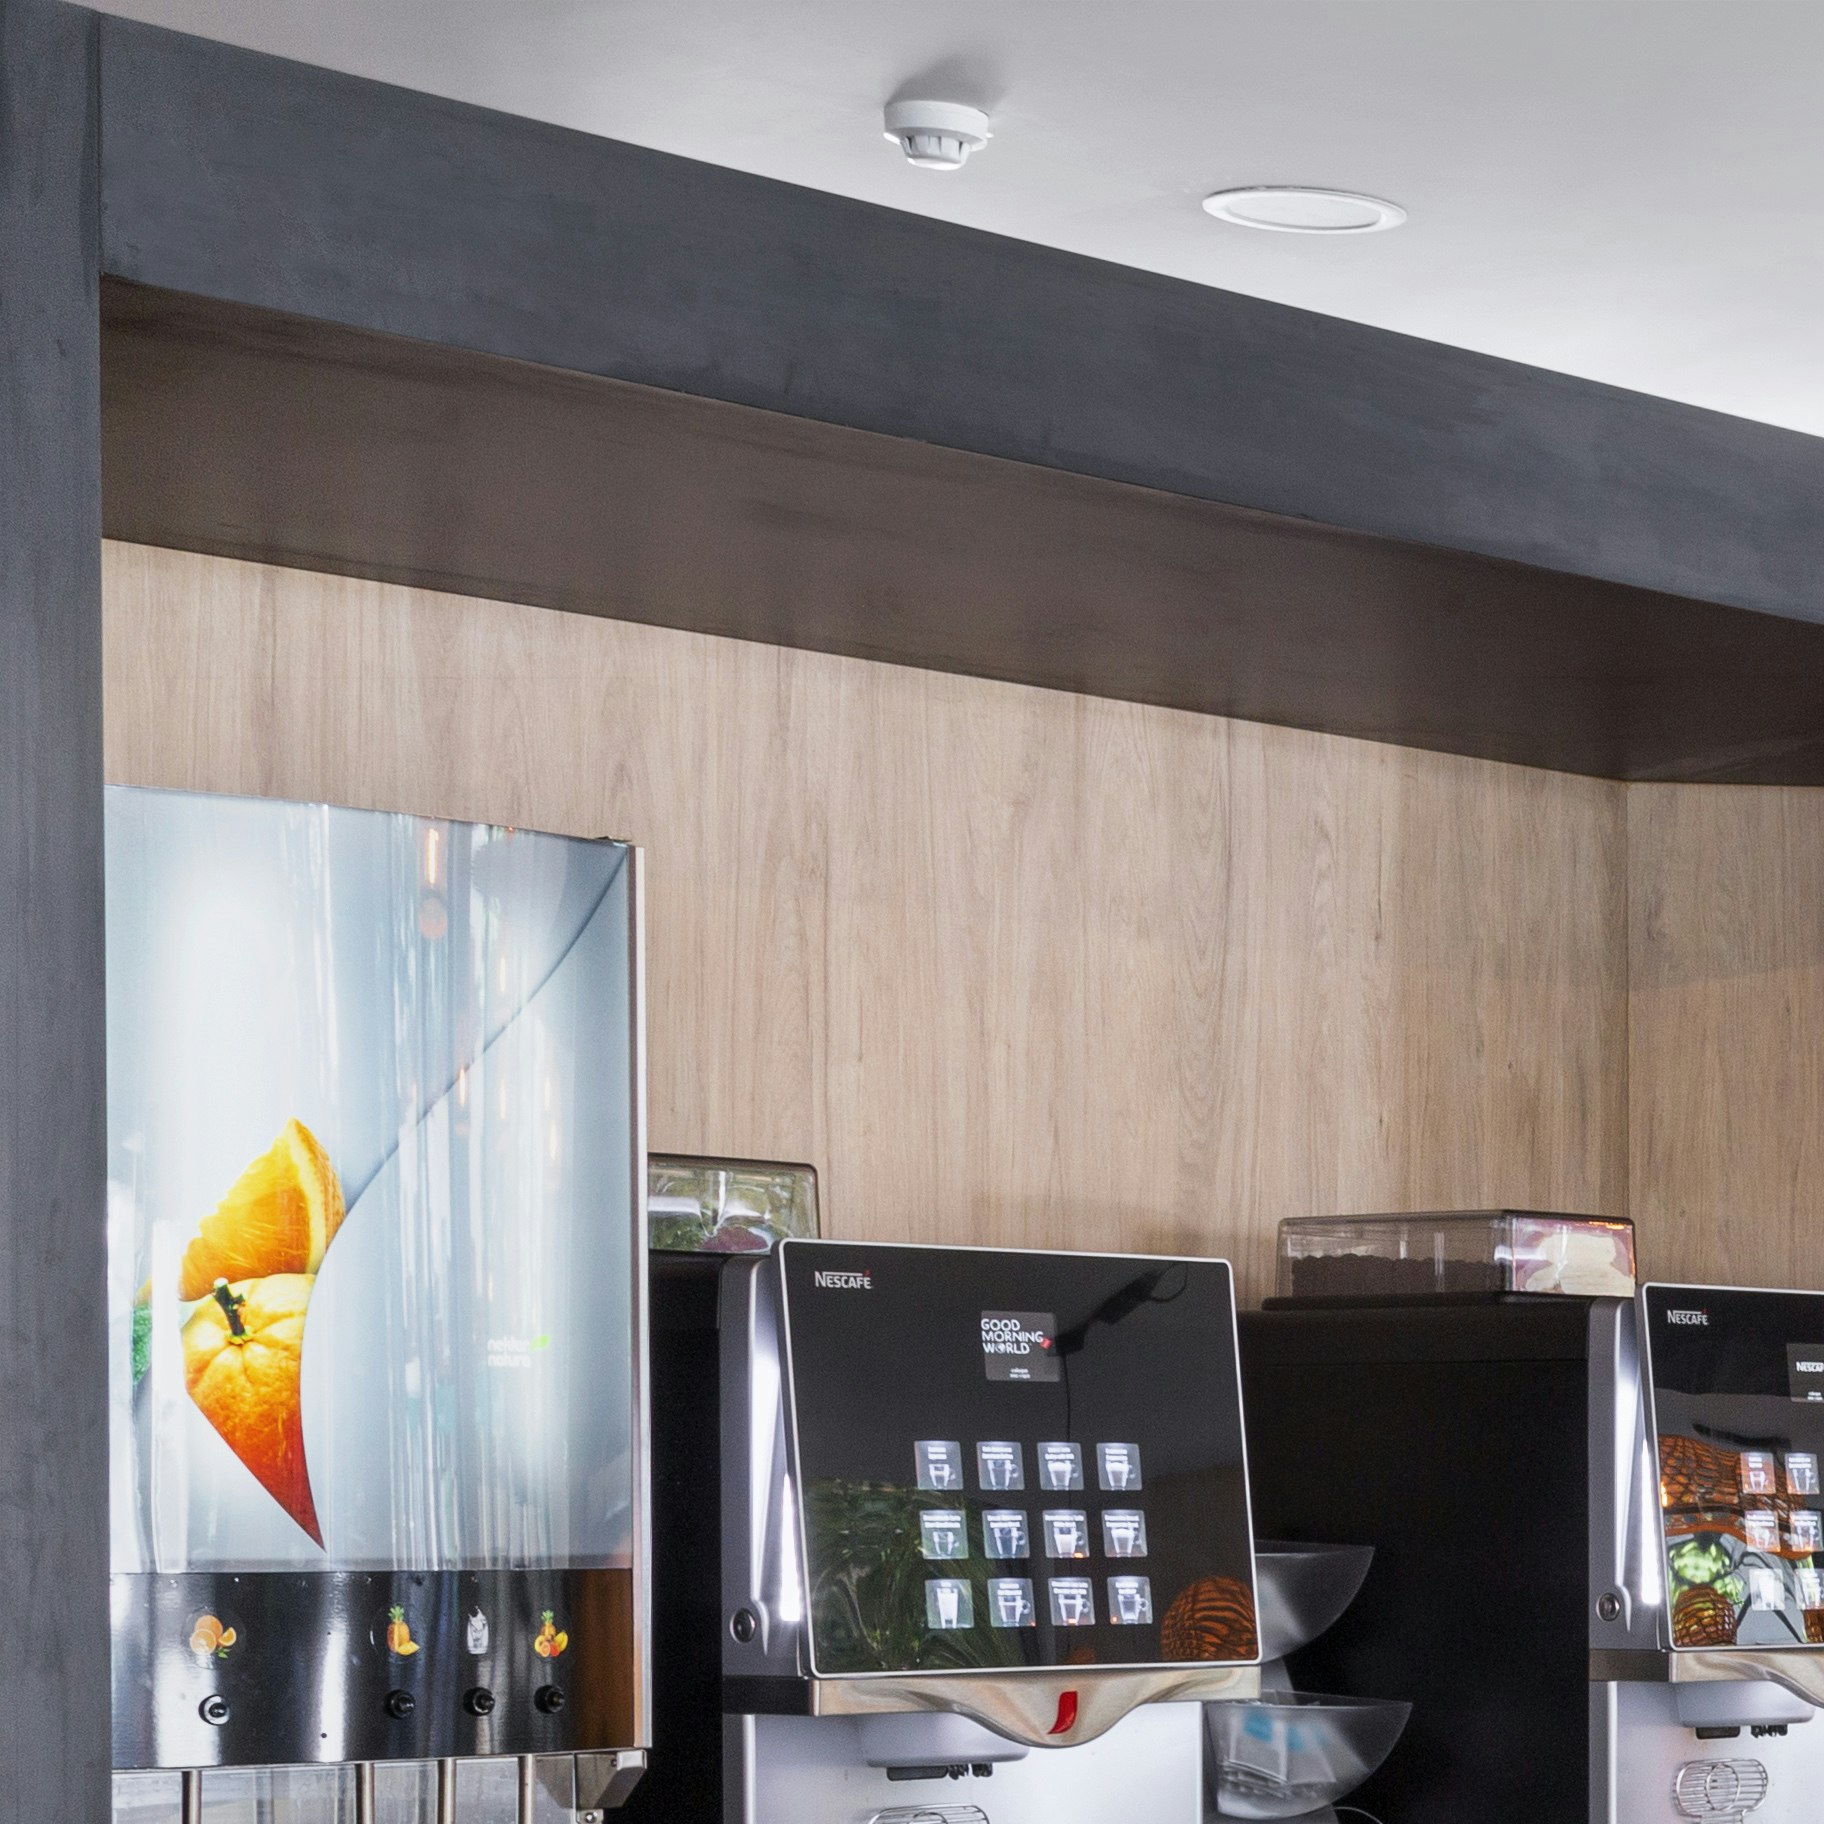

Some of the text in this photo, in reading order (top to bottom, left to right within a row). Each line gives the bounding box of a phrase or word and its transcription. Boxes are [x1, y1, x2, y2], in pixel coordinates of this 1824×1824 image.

[814, 1270, 873, 1290] NESCAFÉ
[981, 1318, 1020, 1331] GOOD
[981, 1331, 1044, 1343] MORNING
[982, 1342, 1030, 1355] WORLD
